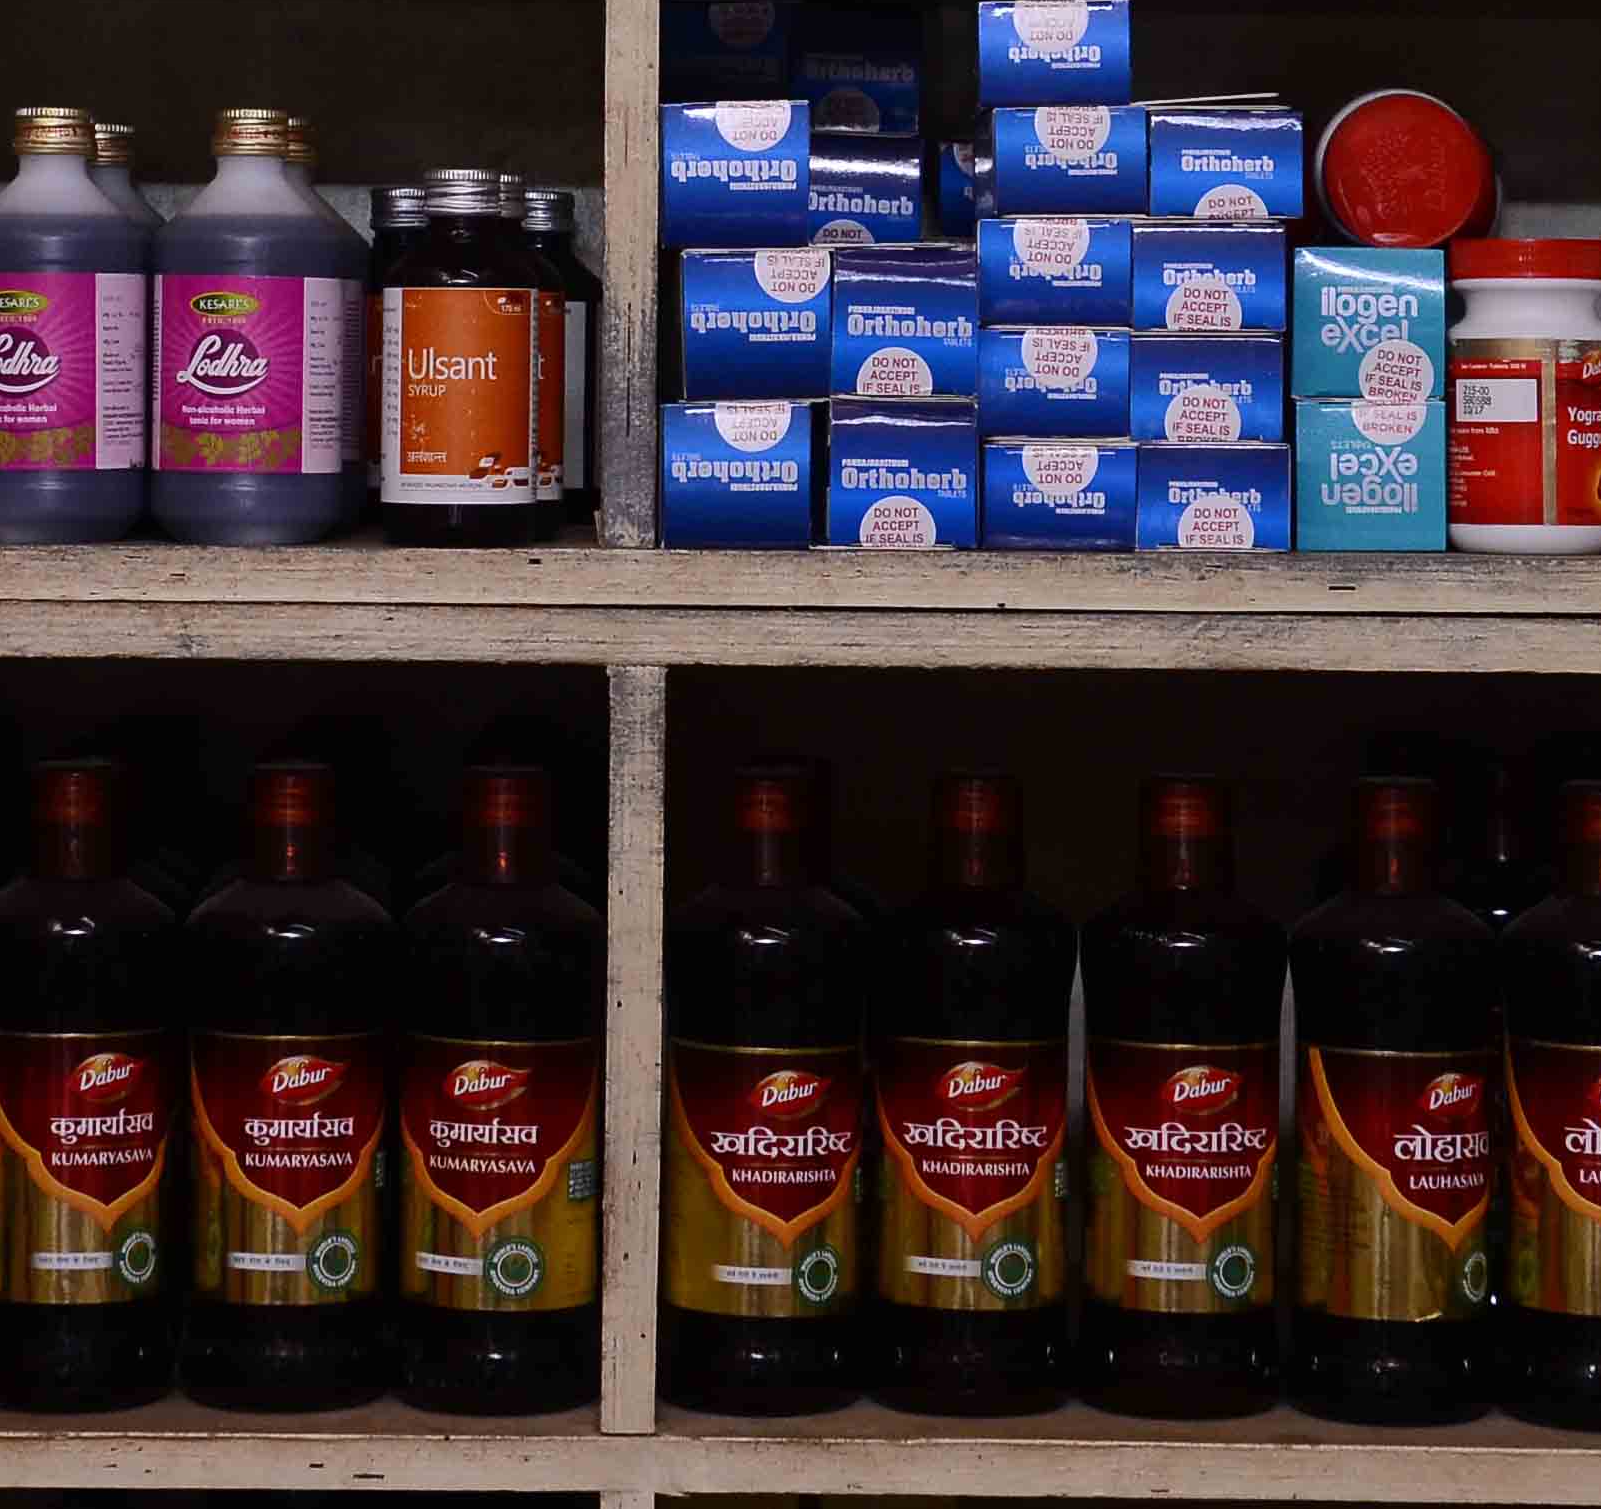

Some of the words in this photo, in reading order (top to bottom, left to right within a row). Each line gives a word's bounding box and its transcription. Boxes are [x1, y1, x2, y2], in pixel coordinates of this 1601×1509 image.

[671, 158, 798, 183] Orthoherb
[1181, 155, 1274, 172] Orthoherb
[847, 313, 973, 339] Orthoherb
[176, 329, 269, 393] Lodhra
[407, 346, 498, 380] Ulsant
[871, 357, 890, 369] DO
[892, 358, 917, 369] NOT
[1377, 349, 1397, 362] DO
[1398, 351, 1422, 366] NOT
[869, 370, 920, 382] ACCEPT
[1374, 362, 1421, 378] ACCEPT
[407, 384, 447, 396] SYRUP
[1367, 387, 1418, 403] BROKEN
[841, 466, 967, 491] Orthoherb
[79, 1062, 135, 1091] Dabur
[271, 1067, 332, 1092] Dabur
[453, 1074, 511, 1096] Dabur
[51, 1148, 154, 1167] KUMARYASAVA
[245, 1151, 353, 1168] KUMARYASAVA
[429, 1154, 536, 1174] KUMARYASAVA
[731, 1168, 837, 1185] KHADIRARISHTA
[922, 1160, 1030, 1177] KHADIRARISHTA
[1145, 1163, 1252, 1180] KHADIRARISHTA
